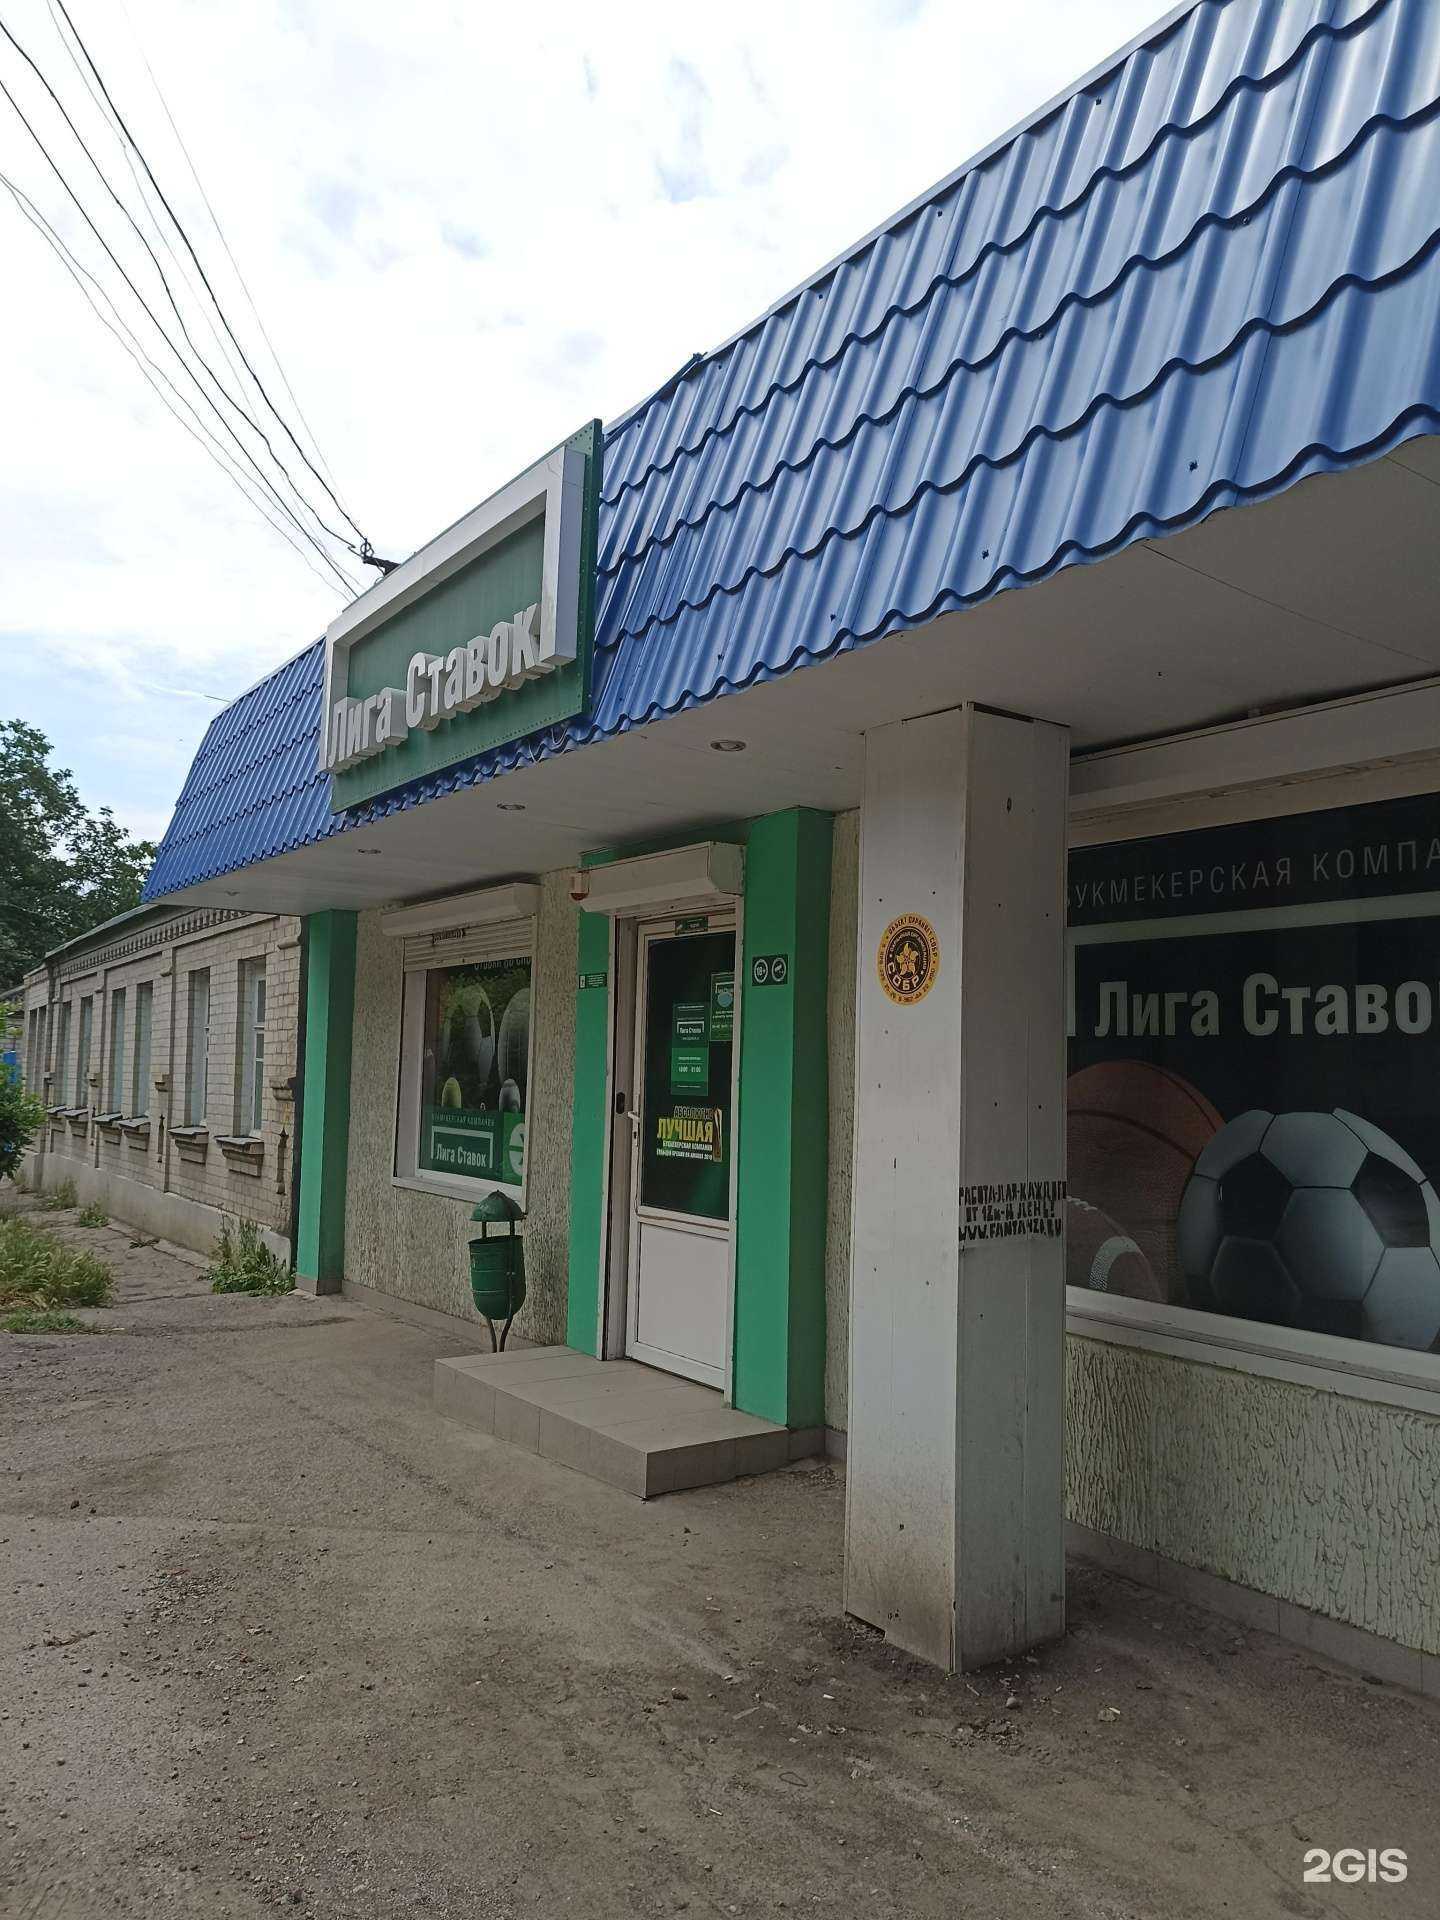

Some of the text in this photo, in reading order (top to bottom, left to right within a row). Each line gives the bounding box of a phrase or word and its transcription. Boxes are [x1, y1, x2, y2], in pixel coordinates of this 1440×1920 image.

[327, 603, 541, 770] Лига Ставок
[1068, 857, 1292, 909] УКМЕКЕРСКАЯ
[1094, 972, 1440, 1038] Лига Ставо
[436, 1143, 487, 1168] Лига Ставок
[657, 1118, 713, 1142] ЛУЧШАЯ
